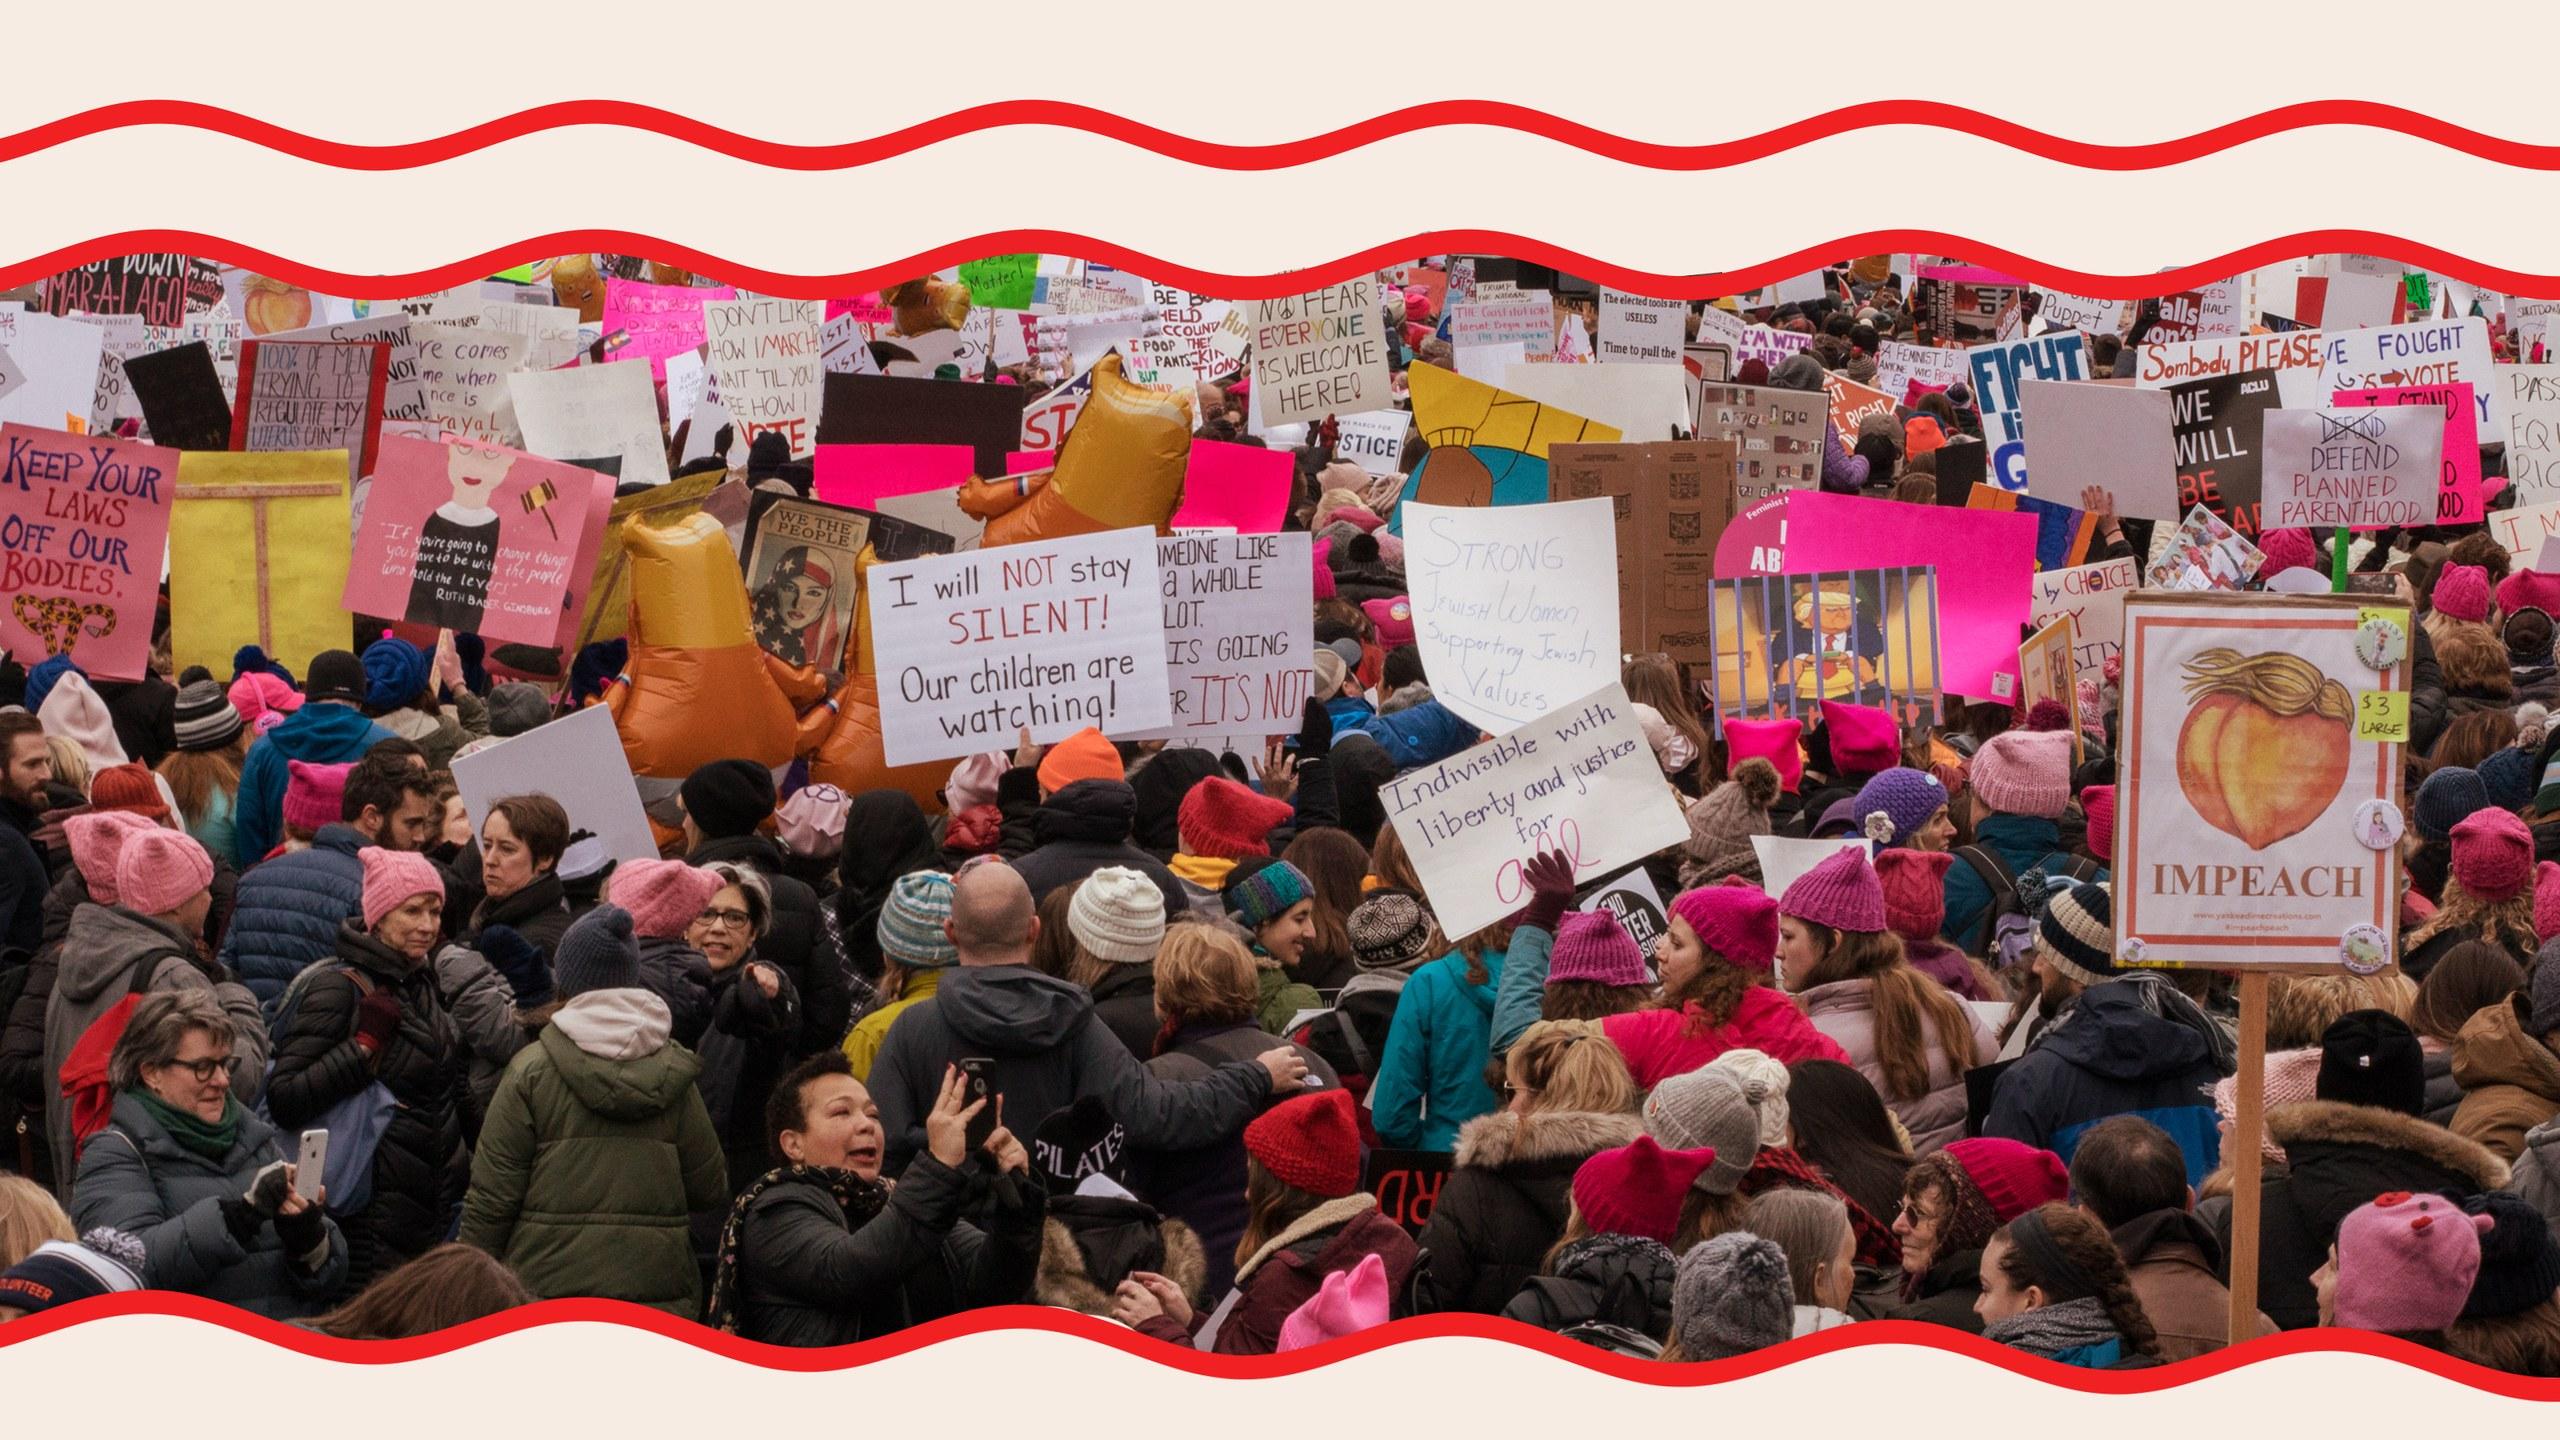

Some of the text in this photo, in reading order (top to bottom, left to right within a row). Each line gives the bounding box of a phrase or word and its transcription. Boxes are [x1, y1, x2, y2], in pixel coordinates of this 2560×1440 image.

[969, 260, 1024, 295] Matter!
[1154, 290, 1178, 305] BE
[1302, 280, 1368, 317] FEAR
[1603, 293, 1618, 304] The
[1619, 294, 1654, 308] elected
[1672, 301, 1682, 309] are
[2042, 294, 2103, 330] Puppet
[2202, 303, 2233, 316] HALF
[710, 301, 774, 338] DON'T
[777, 303, 818, 326] LIKE
[1625, 312, 1658, 325] USELESS
[2210, 324, 2235, 334] ARE
[455, 342, 510, 360] comes
[708, 337, 747, 362] HOW
[763, 323, 820, 359] MARCH?
[1128, 339, 1176, 353] I POOP
[1603, 341, 1677, 361] Time to pull the
[1740, 329, 1769, 348] I'M
[1772, 331, 1813, 352] WITH
[1881, 343, 1942, 367] A FEMINIST
[2239, 333, 2322, 373] PLEASE
[2377, 325, 2465, 361] FOUGHT
[262, 344, 298, 368] 100%
[306, 345, 323, 371] OF
[332, 344, 373, 375] MEN
[1133, 353, 1192, 369] MY PANTS
[1285, 340, 1378, 377] WELCOME
[1878, 360, 1932, 377] ANYONE WHO
[2403, 361, 2461, 386] VOTE
[257, 372, 353, 398] TRYING TO
[455, 368, 498, 387] when
[719, 365, 816, 391] WAIT 'TIL YOU
[1138, 370, 1159, 383] BUT
[1970, 334, 2084, 415] FIGHT
[2240, 379, 2269, 396] ACLU
[464, 387, 478, 406] is
[751, 395, 795, 418] HOW
[1279, 372, 1362, 415] HERE!
[2169, 389, 2213, 428] WE
[254, 400, 326, 424] REGULATE
[334, 402, 365, 428] MY
[1377, 423, 1392, 431] FOR
[2321, 414, 2387, 441] DEFUND
[251, 424, 349, 447] UTERUS CAN'T
[2172, 425, 2248, 467] WILL
[2, 436, 162, 505] KEEP YOUR
[2310, 443, 2400, 473] DEFEND
[2178, 469, 2221, 506] BE
[2293, 473, 2398, 500] PLANNED
[44, 487, 129, 528] LAWS
[1745, 497, 1784, 521] Feminist
[2281, 500, 2422, 525] PARENTHOOD
[777, 521, 851, 548] PEOPLE
[779, 510, 852, 536] WE THE
[2, 513, 132, 575] OFF OUR
[415, 534, 570, 570] you're going to change things
[1235, 535, 1279, 561] LIKE
[1423, 516, 1564, 572] STRONG
[0, 550, 123, 599] BODIES.
[387, 545, 409, 562] you
[436, 552, 450, 564] to
[453, 553, 468, 566] be
[472, 557, 498, 575] with
[505, 562, 525, 578] the
[528, 568, 564, 587] people
[410, 568, 435, 583] hold
[435, 569, 452, 585] the
[889, 554, 1131, 608] I will NOT stay
[1163, 564, 1263, 598] a WHOLE
[2043, 563, 2134, 605] by CHOICE
[435, 588, 552, 616] RUTH BADER GINSBURG
[1163, 600, 1205, 629] LOT.
[948, 594, 1109, 645] SILENT!
[1166, 631, 1289, 665] IS GOING
[1426, 621, 1525, 676] Supporting
[900, 653, 1135, 703] Our children are
[939, 680, 1116, 740] watching!
[1187, 669, 1314, 727] IT'S NOT
[2361, 721, 2404, 736] LARGE
[1383, 703, 1617, 817] Indivisible with
[1416, 738, 1637, 849] liberty and justice
[1515, 813, 1554, 844] for
[2152, 863, 2366, 898] IMPEACH
[1035, 1122, 1125, 1180] PILATES
